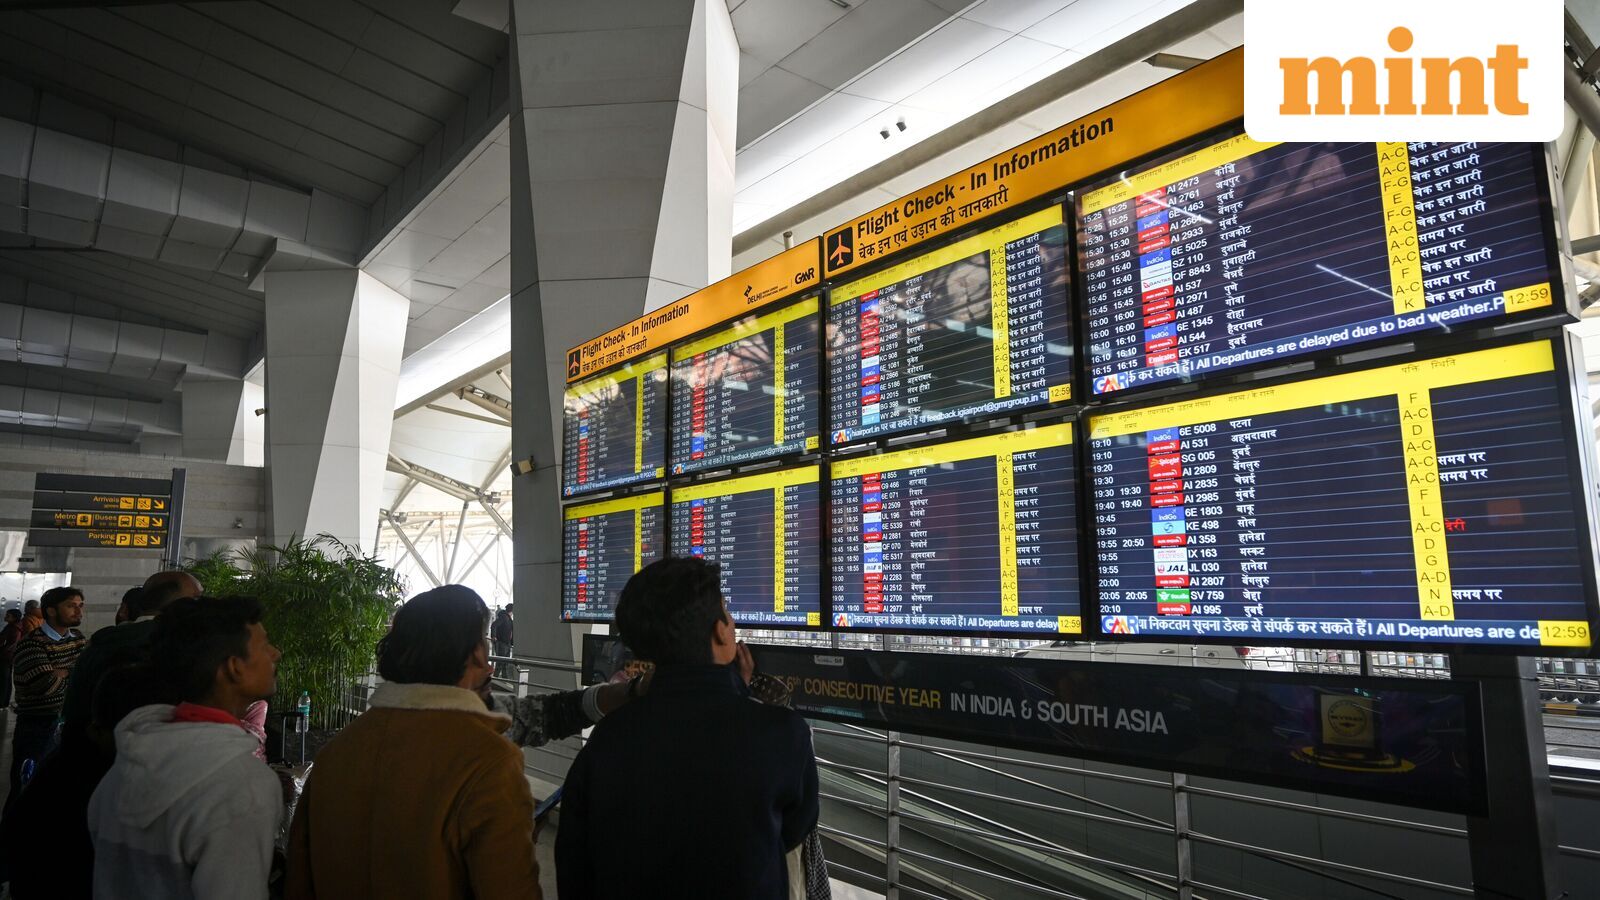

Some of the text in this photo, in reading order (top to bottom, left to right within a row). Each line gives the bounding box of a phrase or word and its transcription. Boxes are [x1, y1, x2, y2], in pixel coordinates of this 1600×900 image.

[858, 206, 899, 238] Flight
[904, 184, 955, 218] Check
[971, 173, 986, 190] In
[994, 118, 1113, 181] Information
[1167, 177, 1199, 194] AI 2473
[1168, 189, 1199, 207] AI 2761
[859, 184, 1008, 258] चेक इन एवं उड़ान की जानकारी
[1171, 227, 1203, 243] AI 2933
[1172, 239, 1207, 255] 6E 5025
[1173, 253, 1203, 268] SZ 110
[795, 268, 814, 284] GMR
[1174, 264, 1210, 280] QF 8843
[1174, 279, 1201, 294] AI 537
[748, 294, 762, 304] DELHI
[1175, 291, 1207, 306] AI 2971
[1510, 288, 1548, 304] 12:59
[1176, 305, 1203, 319] AI 487
[1177, 316, 1213, 331] 6E 1345
[583, 341, 601, 358] Flight
[603, 330, 625, 348] Check
[632, 326, 639, 337] In
[642, 304, 688, 332] Information
[1196, 298, 1506, 369] All Departures are delayed due to bad weather.P
[1178, 331, 1206, 344] AI 544
[1179, 343, 1210, 357] EK 517
[1138, 370, 1153, 380] कर
[1156, 362, 1181, 376] सकते
[1179, 424, 1216, 436] 6E 5008
[1092, 438, 1111, 448] 19:10
[1181, 438, 1208, 449] AI 531
[1093, 451, 1112, 460] 19:10
[1182, 451, 1215, 462] SG 005
[1094, 464, 1112, 472] 19:20
[1182, 465, 1216, 476] AI 2809
[1094, 476, 1113, 485] 19:30
[1184, 478, 1218, 490] AI 2835
[1095, 486, 1141, 497] 19:30 19:30
[1184, 492, 1219, 503] AI 2985
[1096, 500, 1142, 510] 19:40 19:40
[1185, 506, 1222, 516] 6E 1803
[1097, 527, 1116, 535] 19:50
[1186, 520, 1219, 530] KE 498
[1098, 539, 1144, 548] 19:55 20:50
[1187, 535, 1216, 544] AI 358
[1188, 549, 1217, 558] IX 163
[1189, 563, 1219, 572] JL 030
[1190, 577, 1224, 586] AI 2807
[1191, 591, 1224, 600] SV 759
[1192, 605, 1221, 614] AI 995
[968, 618, 977, 626] All
[979, 618, 1019, 628] Departures
[1061, 619, 1080, 629] 12:59
[1150, 616, 1353, 634] निकटतम सूचना डेस्क से संपर्क कर सकते
[1376, 623, 1541, 639] All Departures are de
[1545, 626, 1586, 638] 12:59
[804, 679, 894, 703] CONSECUTIVE
[899, 688, 940, 708] YEAR
[951, 693, 965, 712] IN
[970, 695, 1016, 717] INDIA
[1021, 700, 1032, 719] &
[1038, 701, 1108, 727] SOUTH
[1115, 709, 1168, 734] ASIA
